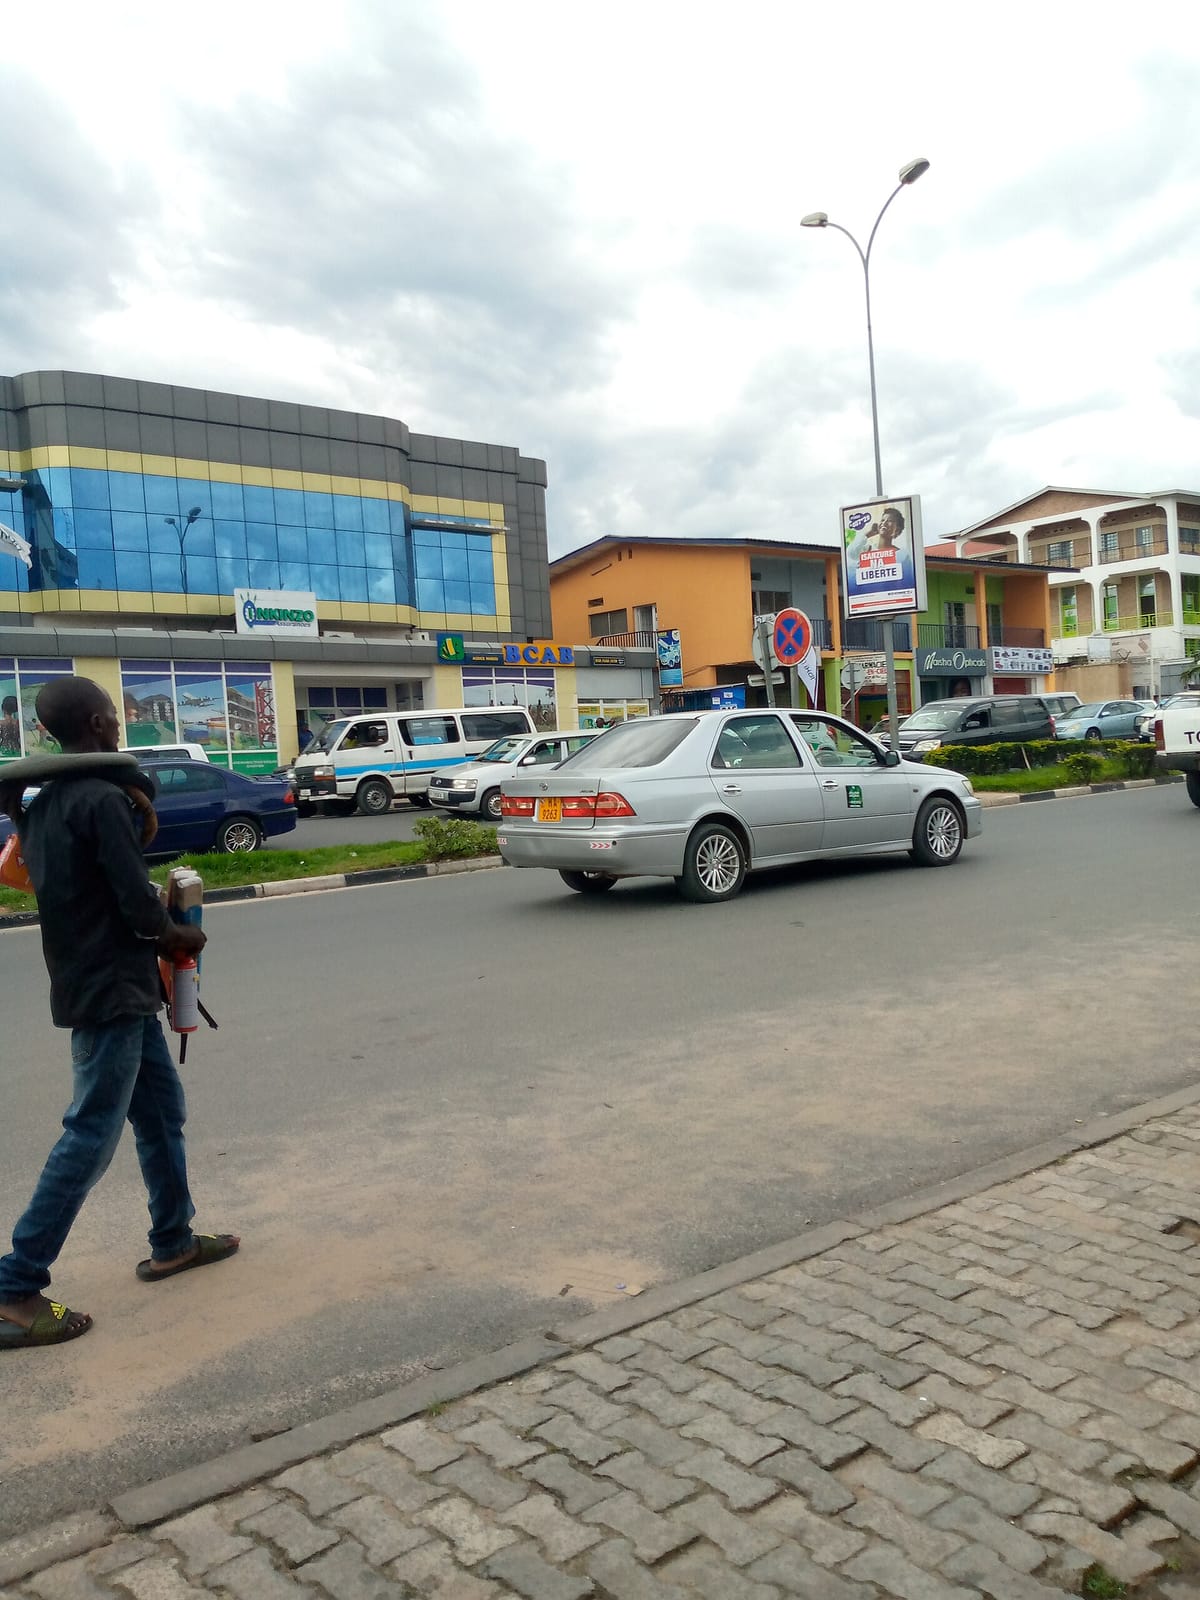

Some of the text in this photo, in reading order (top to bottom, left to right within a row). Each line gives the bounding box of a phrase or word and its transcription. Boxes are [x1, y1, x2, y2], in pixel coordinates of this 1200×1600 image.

[870, 558, 884, 569] NA
[861, 567, 897, 580] LIBERTE
[504, 645, 574, 664] BCAB
